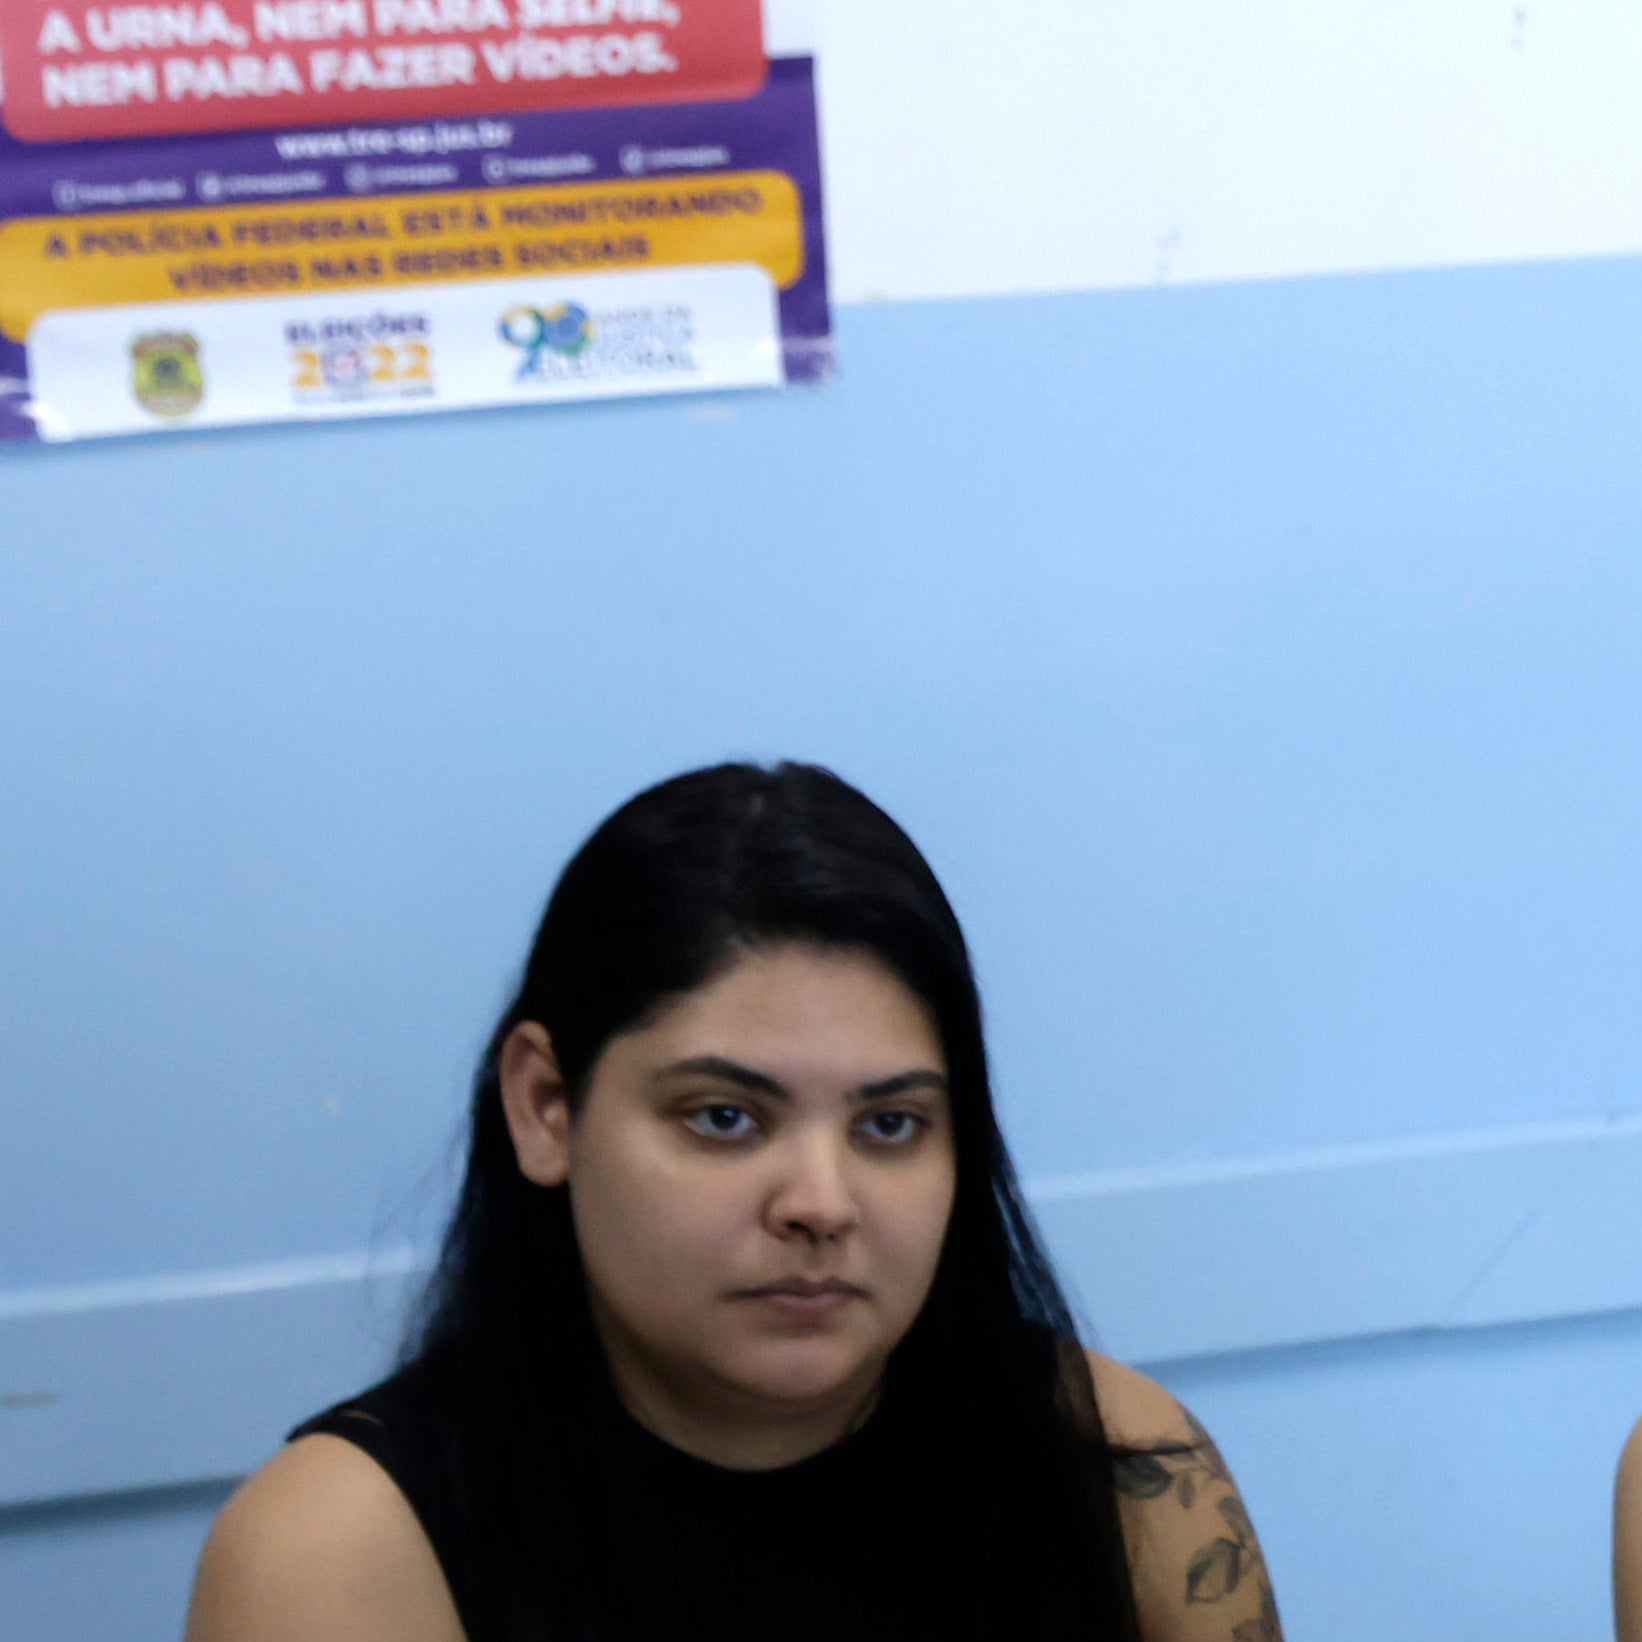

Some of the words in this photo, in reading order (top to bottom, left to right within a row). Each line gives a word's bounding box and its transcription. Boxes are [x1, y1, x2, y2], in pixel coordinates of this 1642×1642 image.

[38, 10, 81, 53] A
[85, 3, 249, 50] URNA,
[254, 0, 367, 42] NEM
[42, 61, 157, 107] NEM
[162, 53, 304, 101] PARA
[309, 42, 475, 94] FAZER
[480, 29, 679, 82] VÍDEOS.
